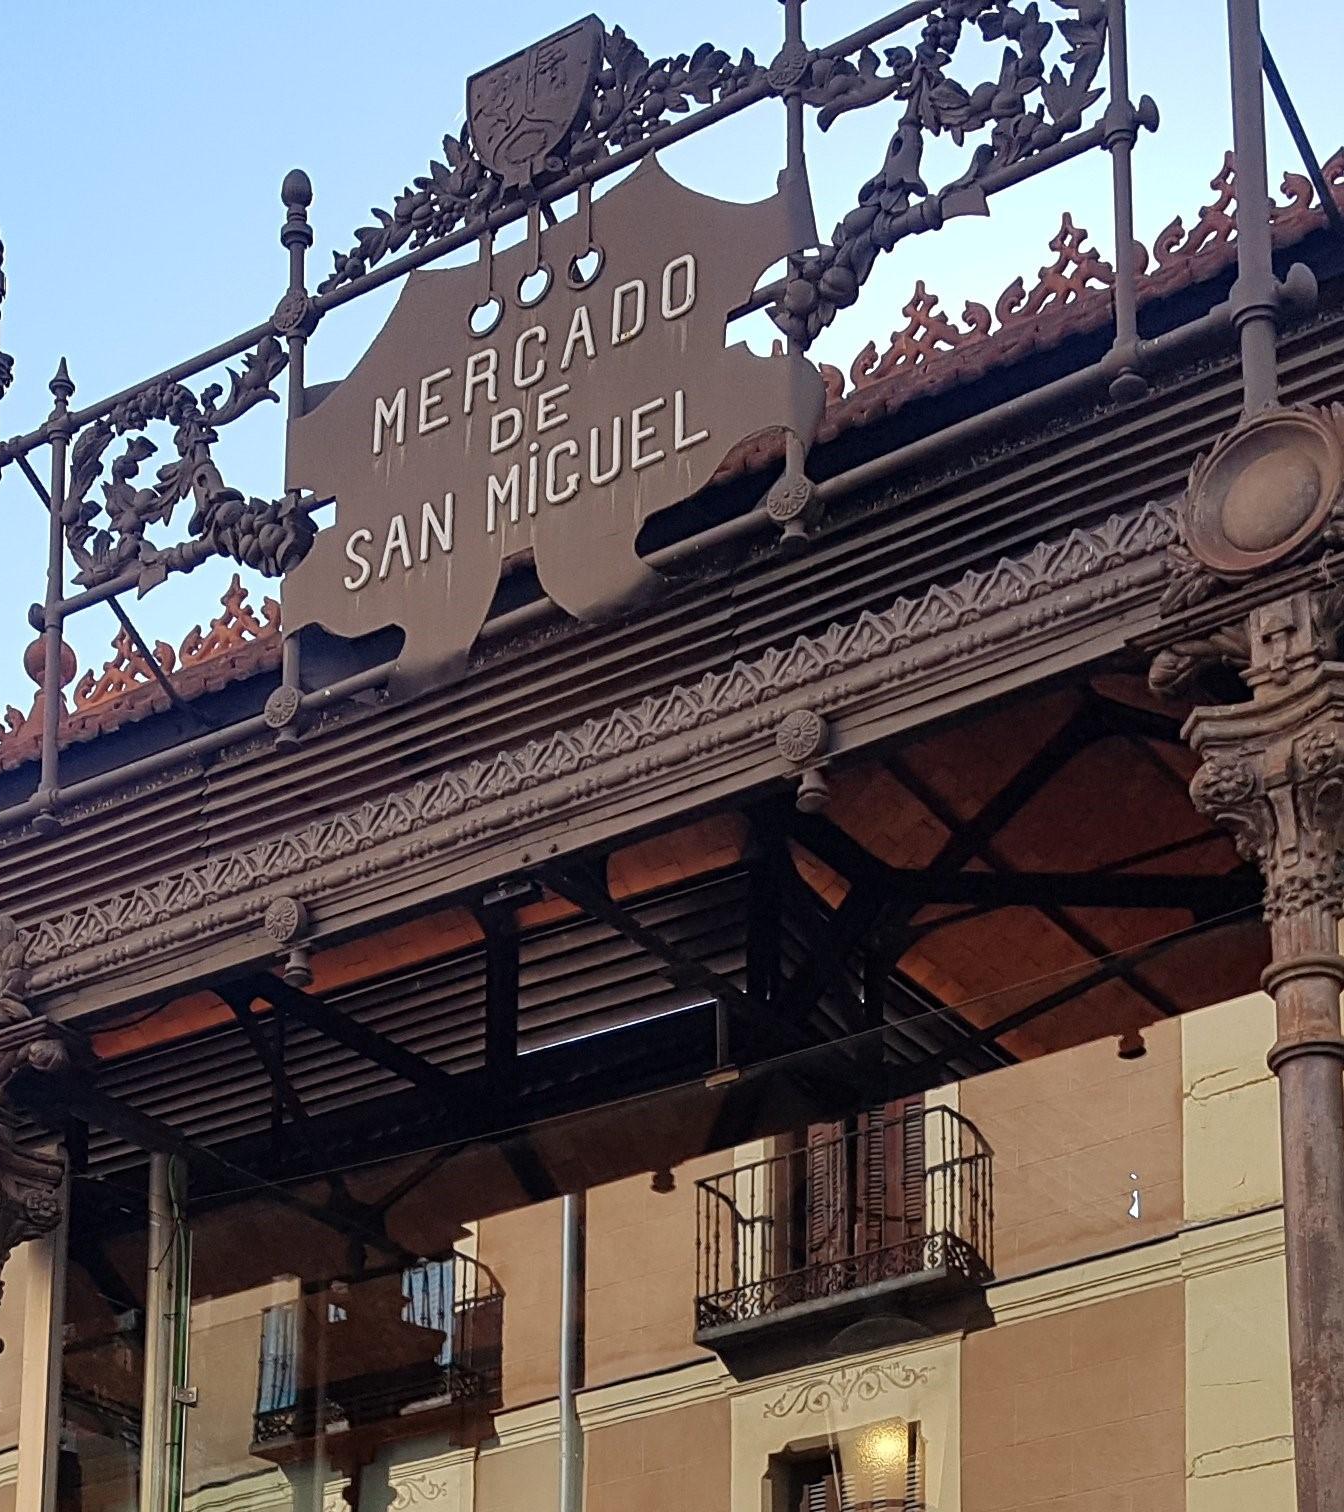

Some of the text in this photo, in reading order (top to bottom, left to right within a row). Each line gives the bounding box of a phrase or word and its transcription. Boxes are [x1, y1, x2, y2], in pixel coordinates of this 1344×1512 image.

[371, 252, 697, 456] MERCADO
[489, 382, 570, 455] DE
[343, 491, 455, 592] SAN
